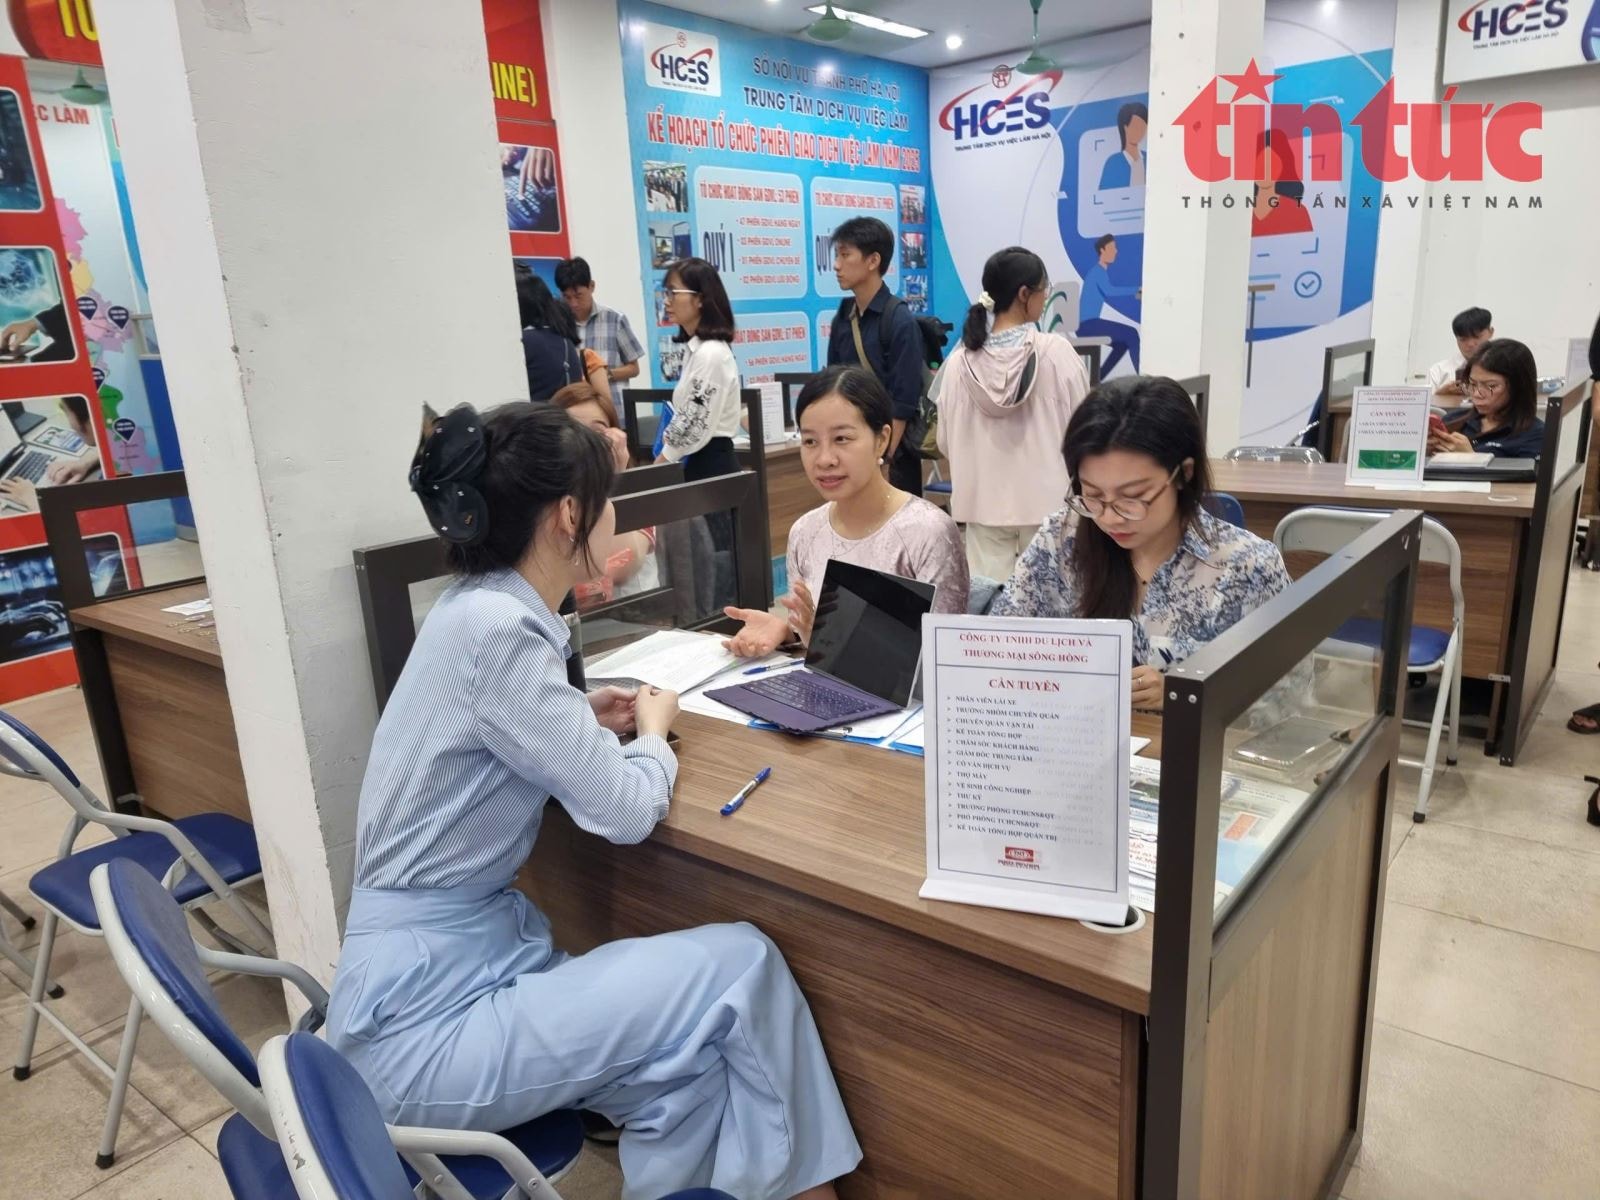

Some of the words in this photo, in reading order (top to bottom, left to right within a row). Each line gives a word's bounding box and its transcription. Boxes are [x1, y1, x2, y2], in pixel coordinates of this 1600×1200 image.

[1473, 0, 1569, 41] HCES
[660, 53, 709, 85] HCES
[492, 62, 538, 108] INE)
[53, 103, 90, 125] LÀM
[744, 86, 786, 112] TRUNG
[789, 93, 813, 115] TÂM
[816, 99, 845, 123] DỊCH
[847, 106, 863, 127] VỤ
[864, 105, 886, 131] VIỆC
[888, 109, 909, 131] LÀM
[954, 92, 1051, 141] HCES
[647, 104, 665, 142] KẾ
[667, 115, 708, 152] HOẠCH
[711, 112, 725, 149] TỔ
[728, 121, 757, 152] CHỨC
[760, 126, 790, 157] PHIÊN
[793, 132, 815, 159] GIAO
[818, 135, 839, 166] DỊCH
[842, 134, 860, 169] VIỆC
[863, 137, 881, 166] LÀM
[882, 140, 900, 169] NĂM
[703, 222, 726, 273] QUÝ
[960, 632, 986, 642] CÔNG
[990, 634, 1001, 642] TY
[1005, 635, 1032, 644] TNHH
[1035, 637, 1048, 645] DU
[1051, 637, 1075, 647] LỊCH
[1078, 638, 1092, 647] VÀ
[963, 648, 1005, 659] THƯƠNG
[1007, 652, 1026, 661] MẠI
[1029, 651, 1055, 661] SÔNG
[989, 677, 1014, 688] CẦN
[1017, 679, 1060, 692] TUYỂN
[986, 708, 1007, 716] NHÓM
[1008, 710, 1037, 718] CHUYÊN
[993, 741, 1018, 750] KHÁCH
[1019, 744, 1039, 752] HÀNG
[984, 784, 1004, 792] CÔNG
[1005, 786, 1031, 795] NGHIỆP
[986, 805, 1012, 814] PHÒNG
[973, 815, 996, 823] PHÒNG
